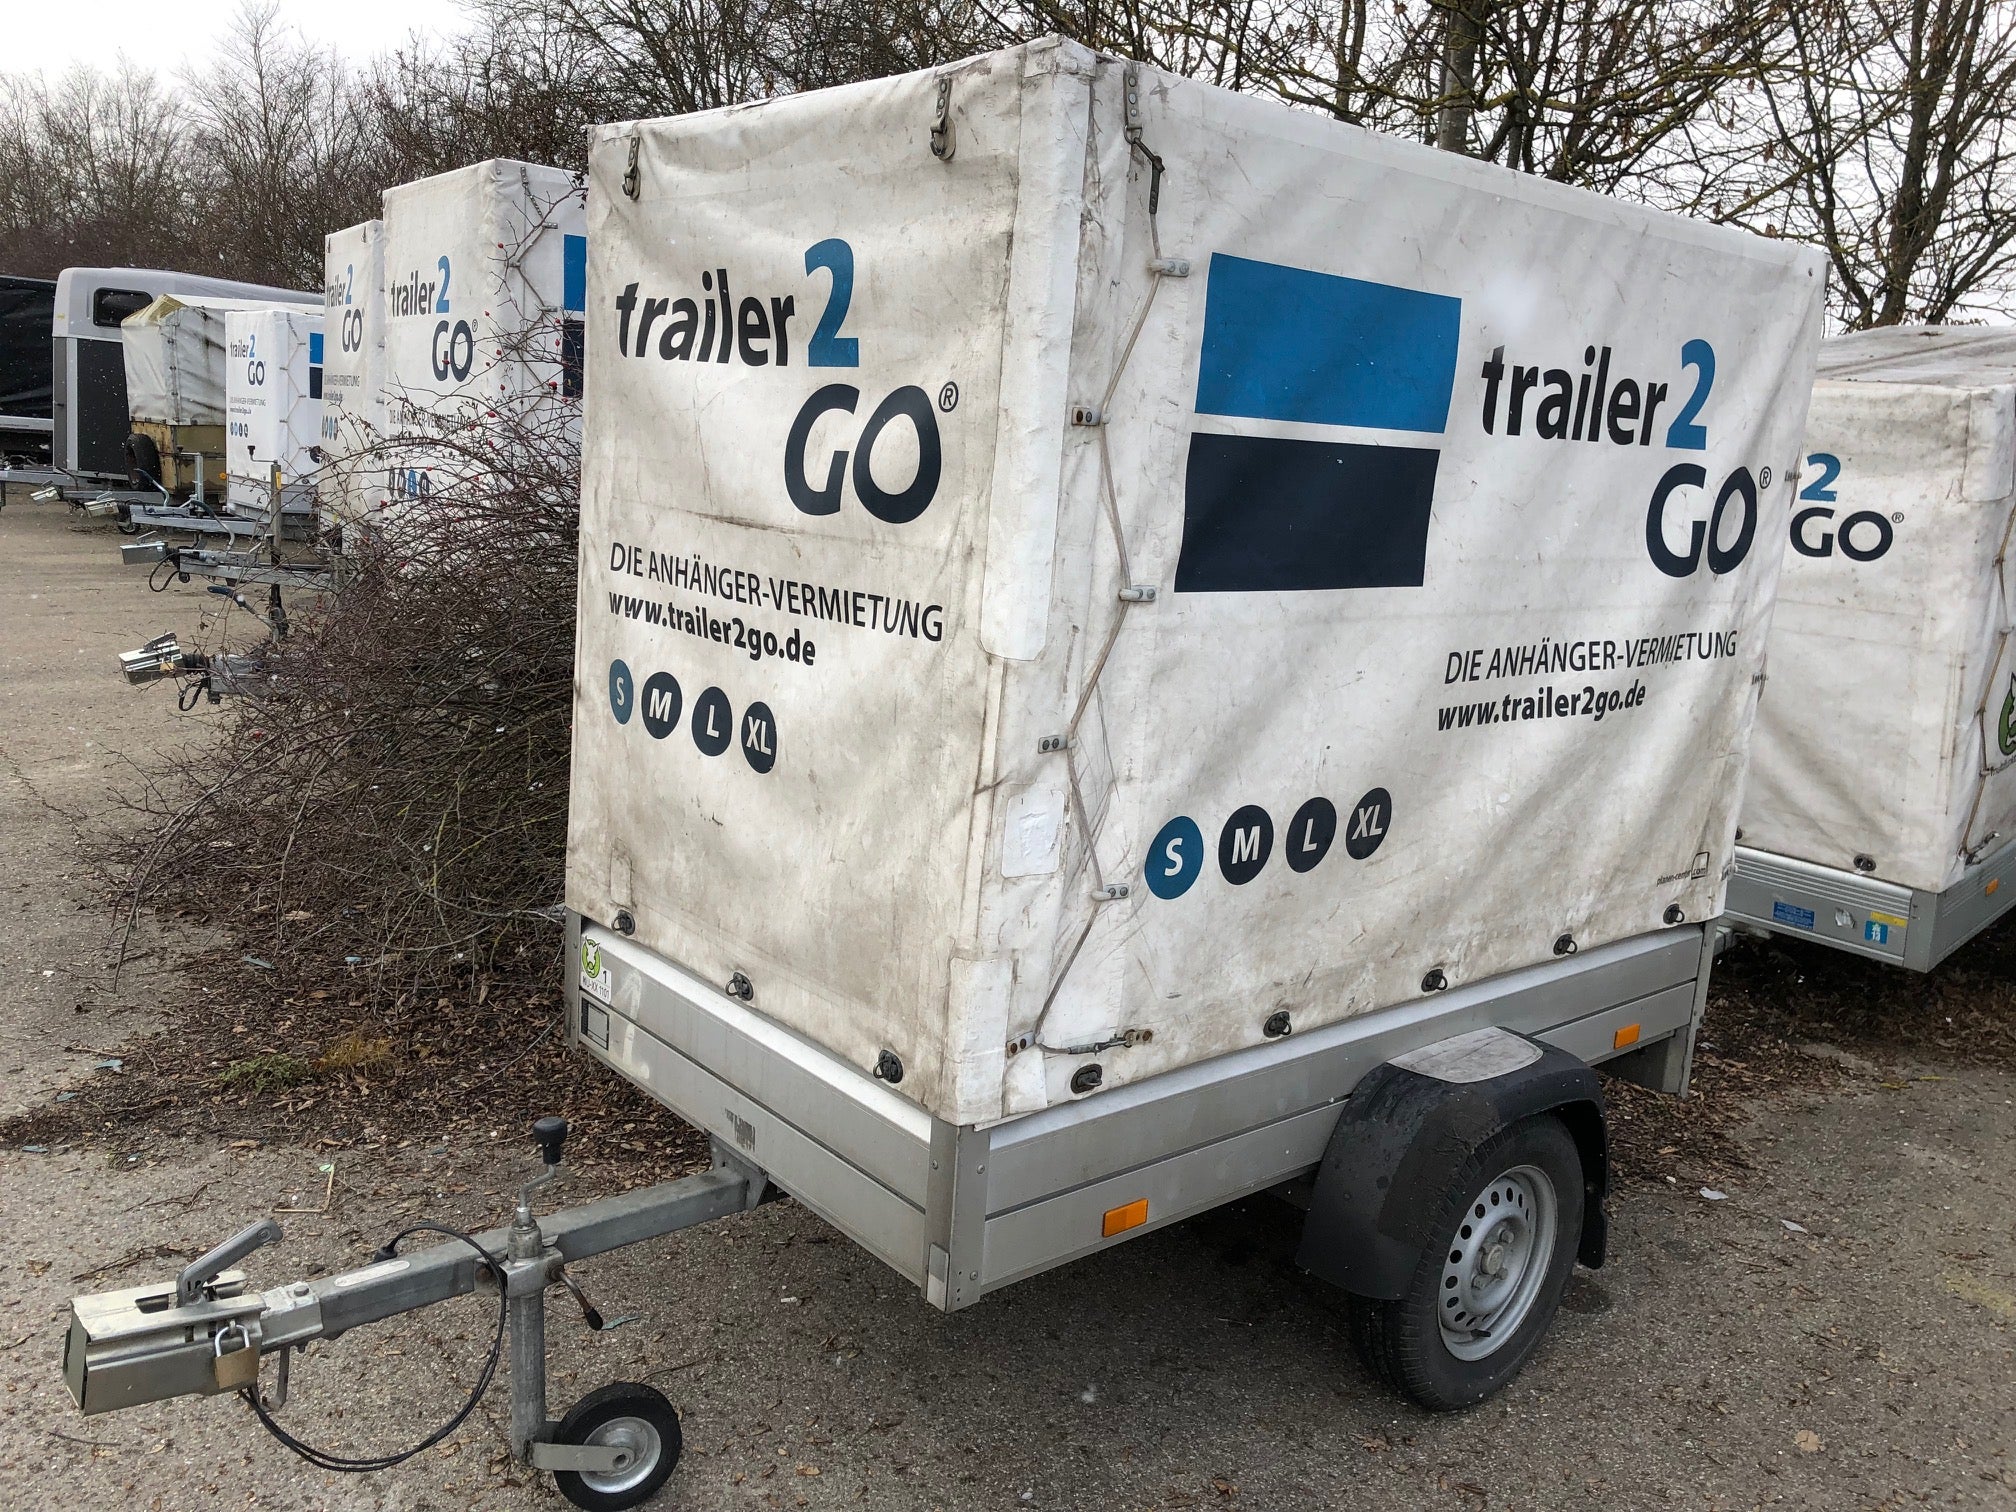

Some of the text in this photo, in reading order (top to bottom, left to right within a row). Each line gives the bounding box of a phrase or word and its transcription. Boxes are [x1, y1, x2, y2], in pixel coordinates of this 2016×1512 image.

[1800, 453, 1841, 502] 2
[609, 542, 944, 642] DIE ANHÄNGER-VERMIETUNG
[609, 592, 816, 666] www.trailer2go.de
[1444, 630, 1738, 684] DIE ANHÄNGER-VERMIETUNG
[616, 676, 772, 755] S M L XL
[1438, 679, 1646, 731] www.trailer2go.de
[1164, 804, 1383, 877] S M L XL
